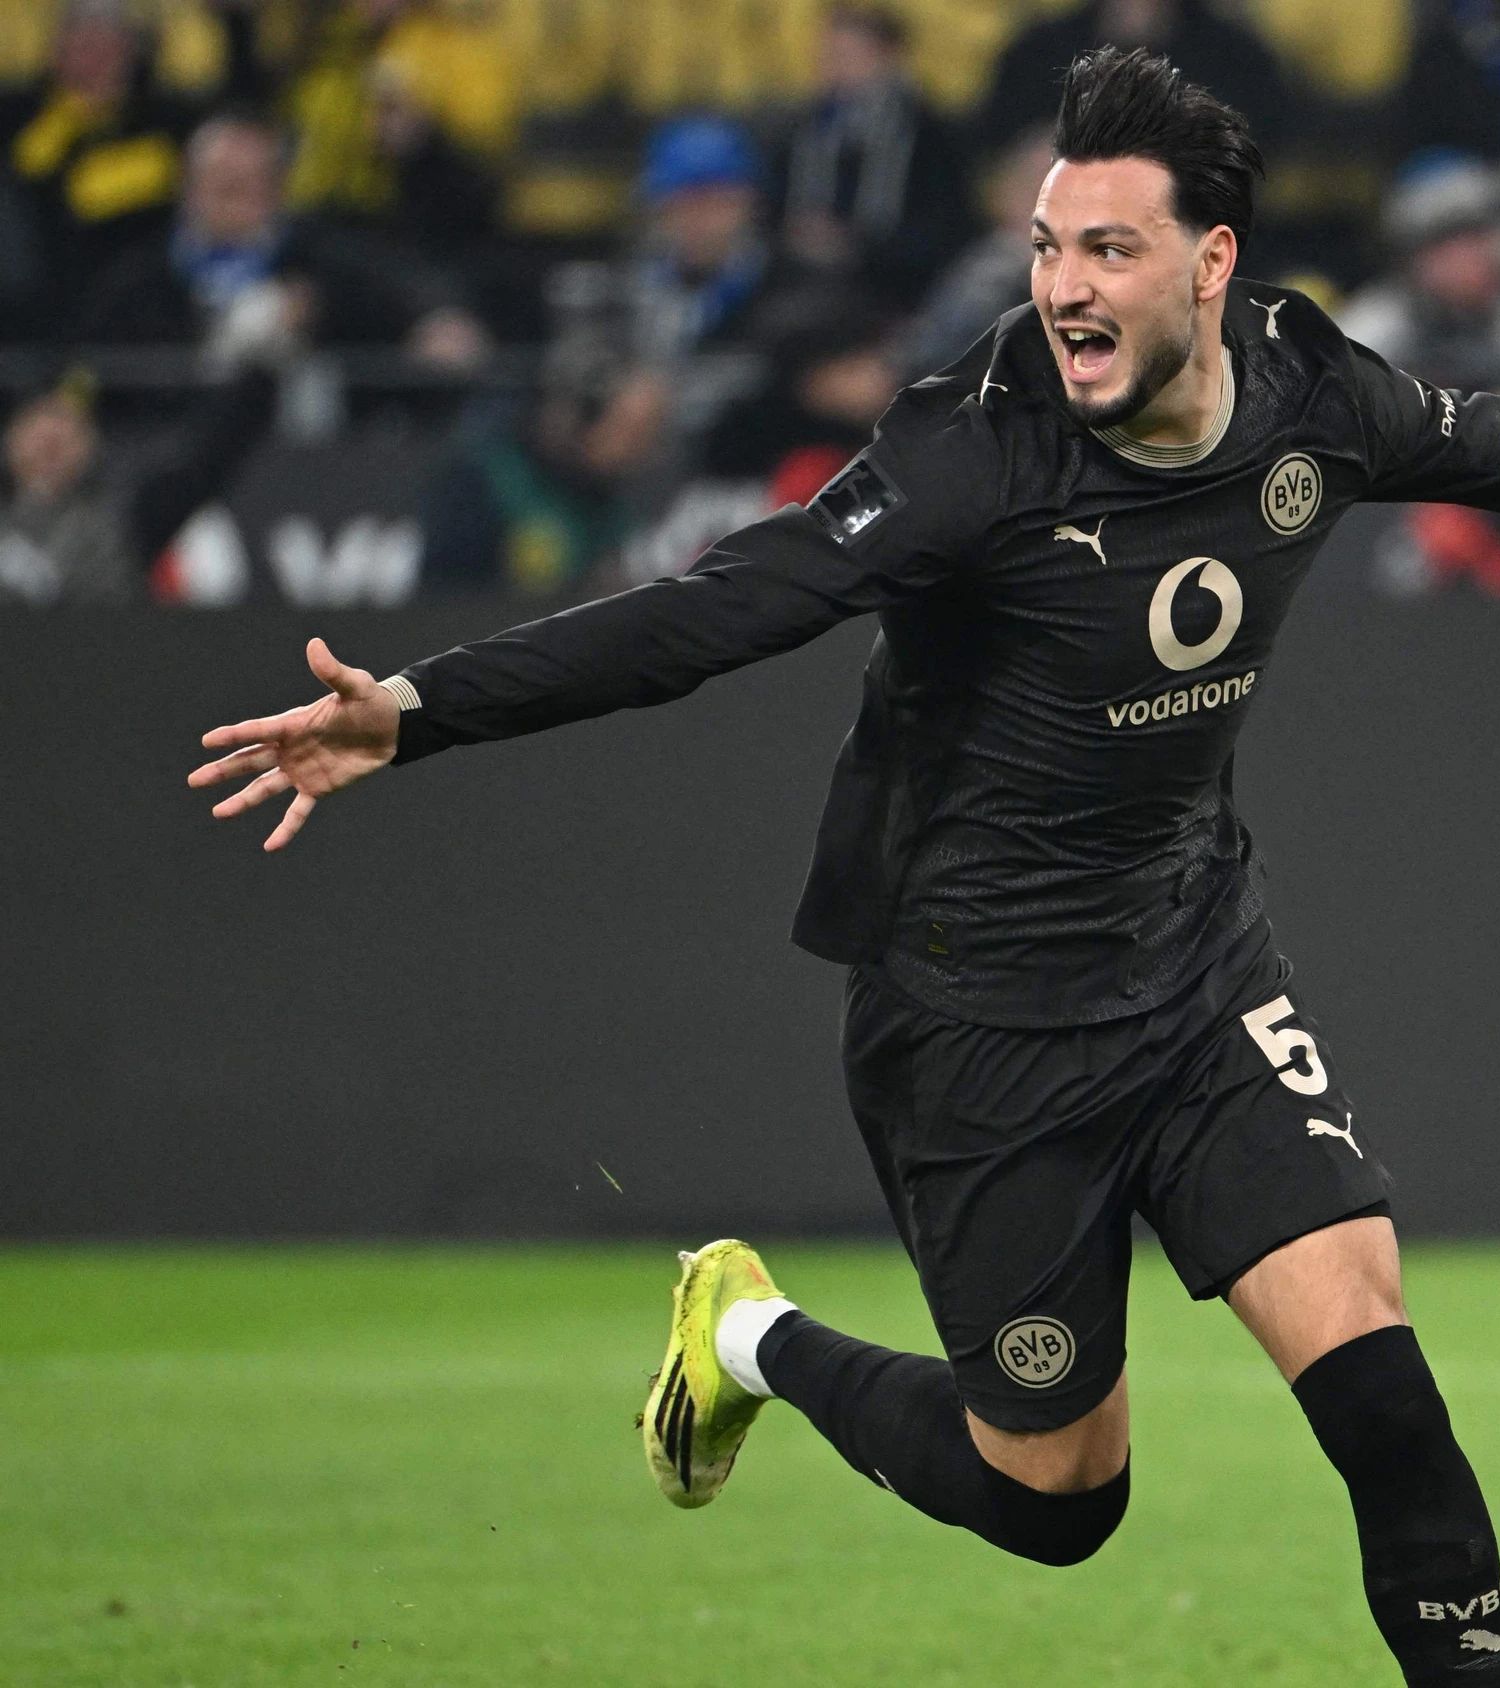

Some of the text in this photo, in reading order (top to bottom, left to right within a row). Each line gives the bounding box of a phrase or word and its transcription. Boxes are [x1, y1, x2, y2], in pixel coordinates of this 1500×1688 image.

[1275, 469, 1313, 510] BVB
[1288, 504, 1300, 518] 09
[1106, 671, 1256, 728] vodafone
[1241, 994, 1328, 1096] 5
[1008, 1330, 1062, 1368] BVB
[1033, 1360, 1051, 1373] 09
